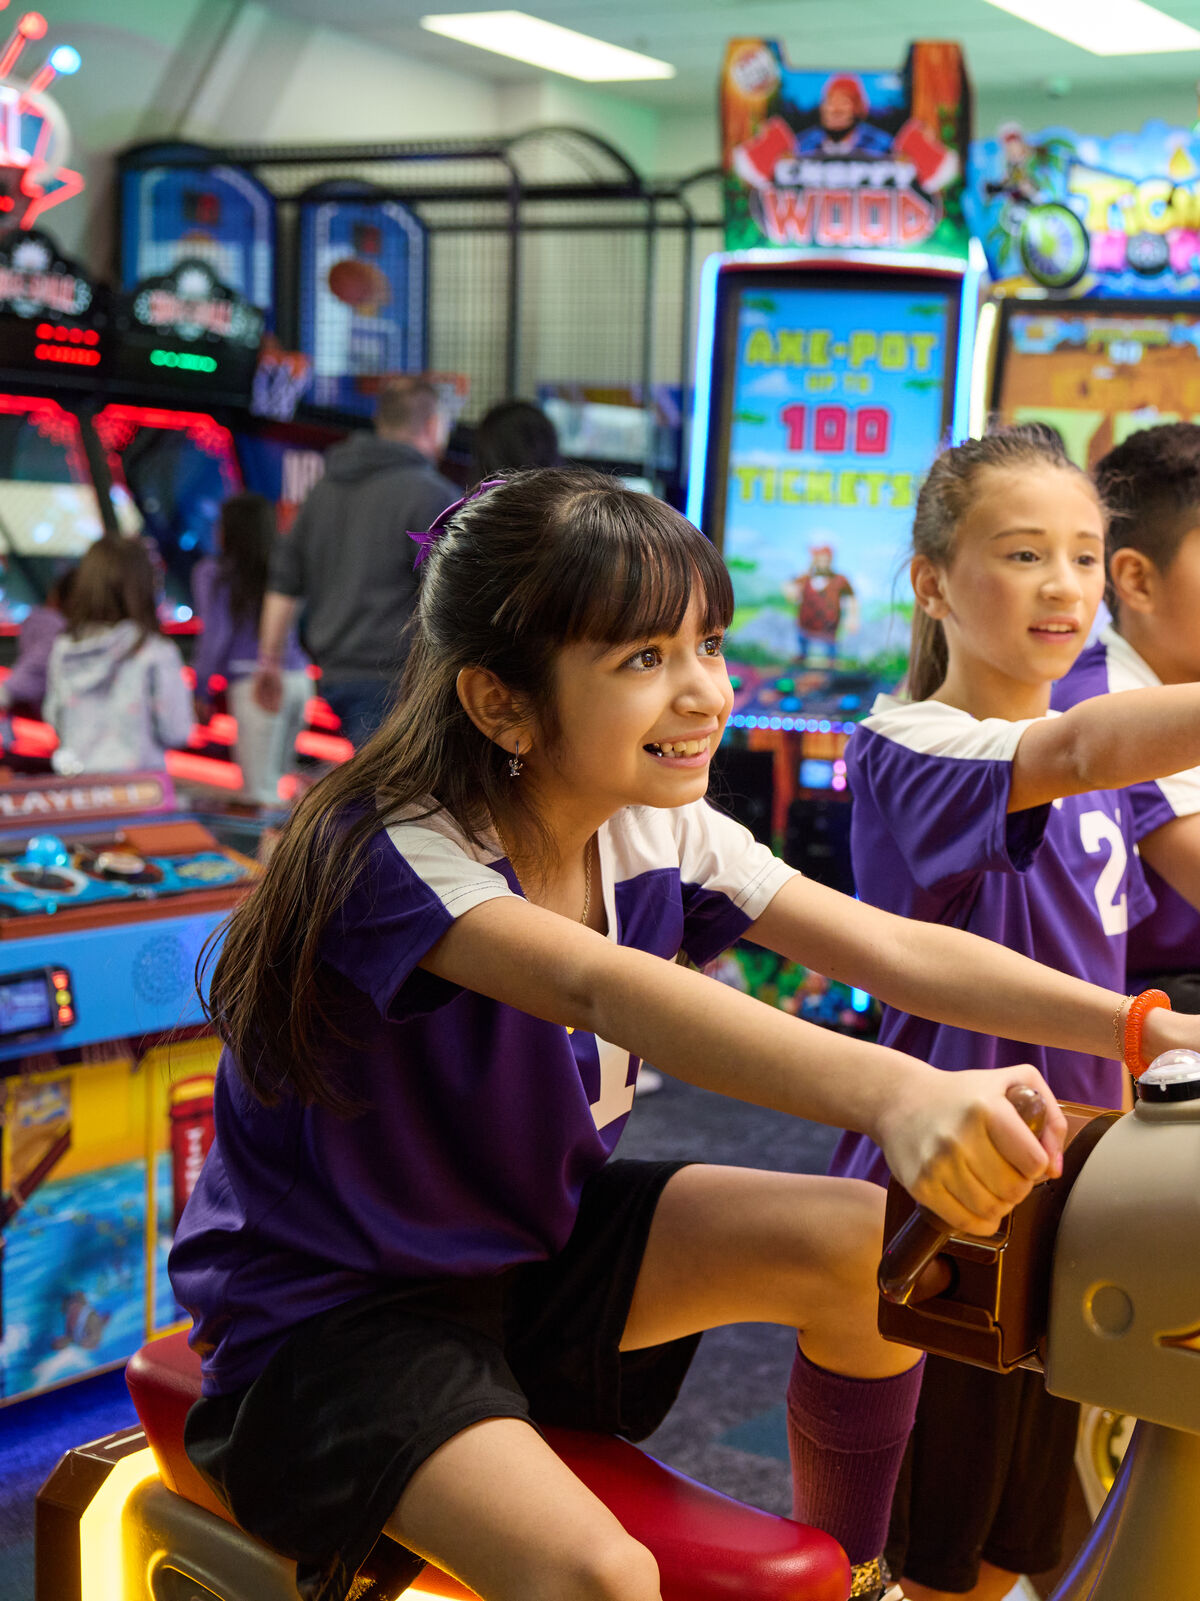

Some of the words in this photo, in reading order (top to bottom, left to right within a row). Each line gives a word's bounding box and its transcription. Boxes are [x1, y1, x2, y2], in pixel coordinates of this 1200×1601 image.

[760, 186, 938, 247] WOOD
[746, 328, 937, 371] AXE-POT
[781, 403, 890, 455] 100
[733, 465, 914, 507] TICKETS
[0, 784, 115, 817] LAYER
